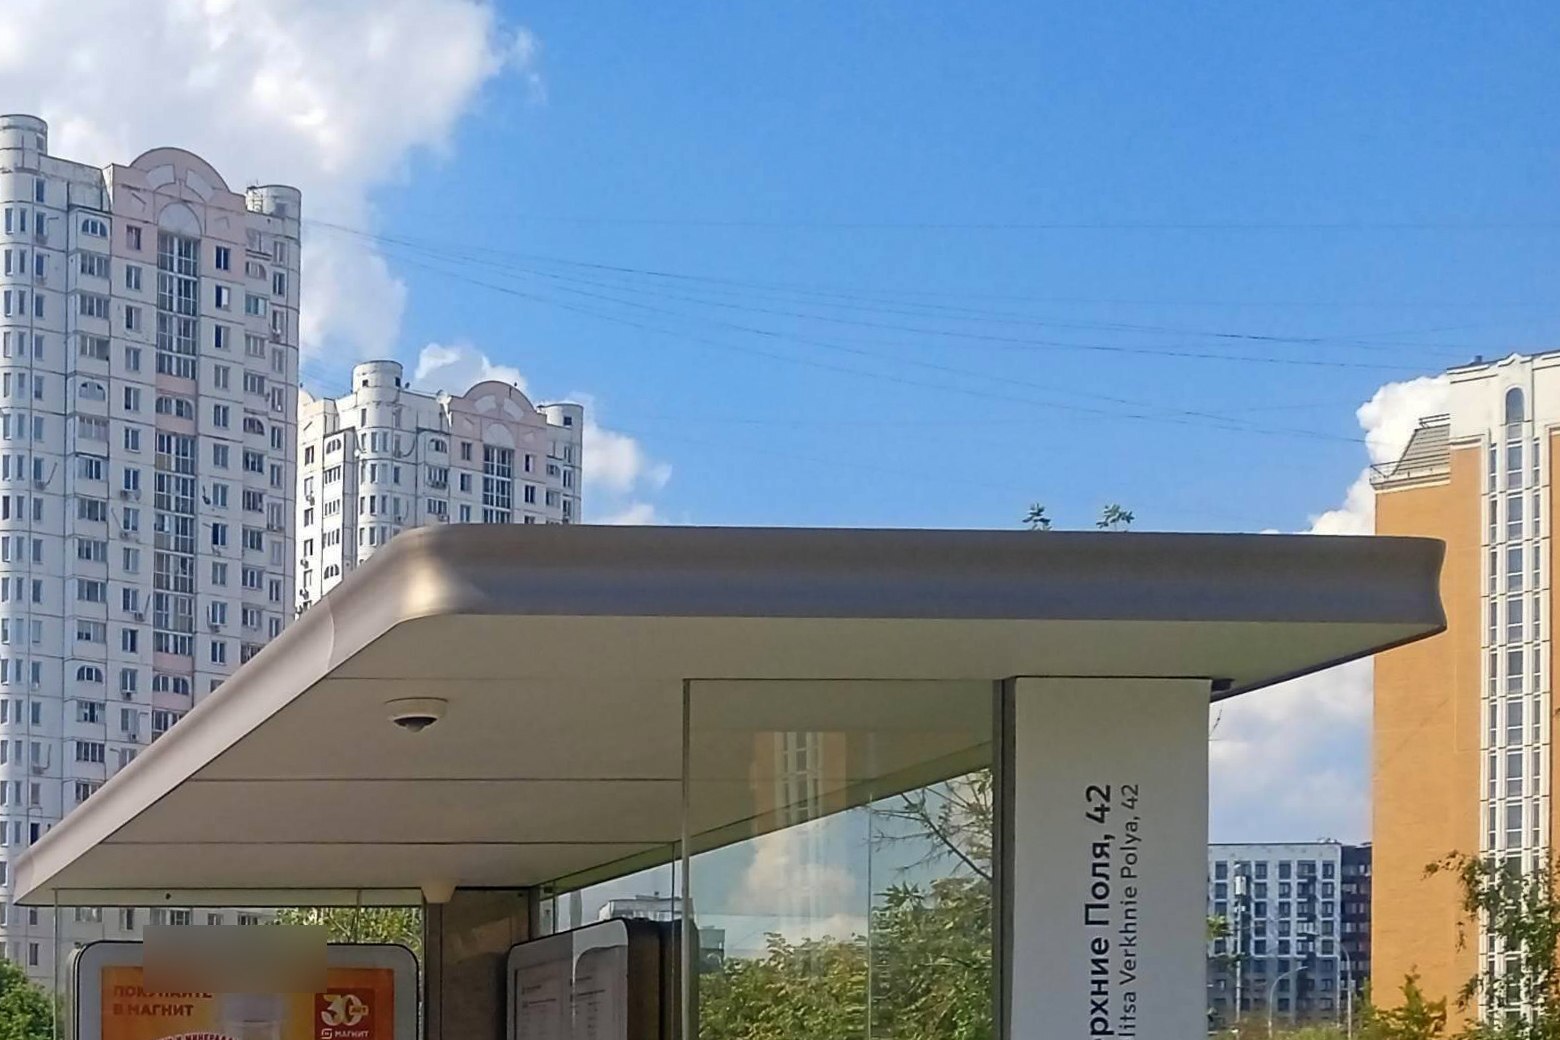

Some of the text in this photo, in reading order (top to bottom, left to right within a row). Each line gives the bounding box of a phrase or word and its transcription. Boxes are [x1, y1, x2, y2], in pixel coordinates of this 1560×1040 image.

[1085, 784, 1111, 824] 42
[1120, 784, 1139, 810] 42
[1119, 815, 1142, 879] Polya,
[1084, 833, 1116, 926] Поля,
[1118, 886, 1138, 986] Verkhnie
[127, 1003, 194, 1017] МАГНИТ
[334, 1030, 369, 1038] МАГНИТ
